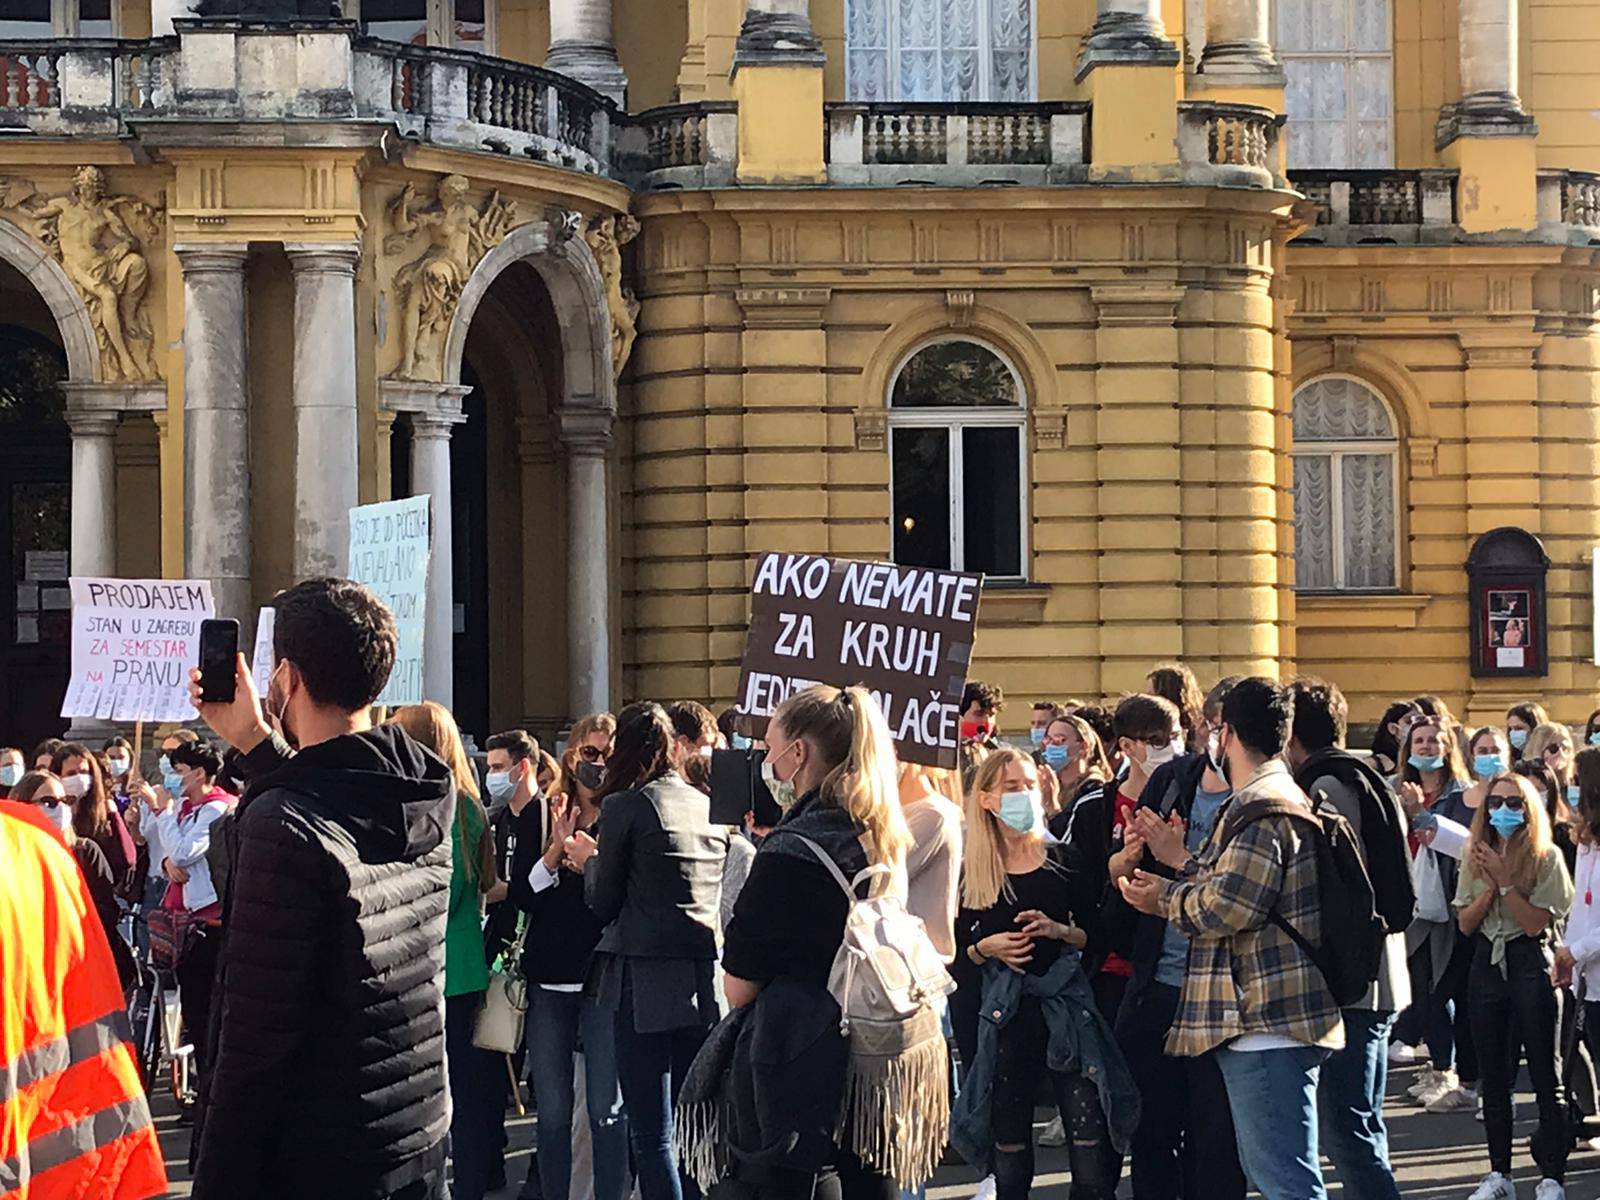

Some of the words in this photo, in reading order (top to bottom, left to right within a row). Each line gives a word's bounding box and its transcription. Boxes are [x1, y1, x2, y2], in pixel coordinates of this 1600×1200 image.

[370, 517, 381, 544] JE
[88, 583, 206, 611] PRODAJEM
[753, 553, 830, 600] AKO
[838, 562, 977, 622] NEMATE
[86, 616, 122, 635] STAN
[132, 618, 141, 635] U
[147, 618, 196, 636] ZAGREBU
[89, 638, 109, 656] ZA
[120, 638, 188, 658] SEMESTAR
[774, 612, 814, 659] ZA
[840, 620, 940, 677] KRUH
[86, 670, 104, 683] NA
[112, 658, 182, 688] PRAVU
